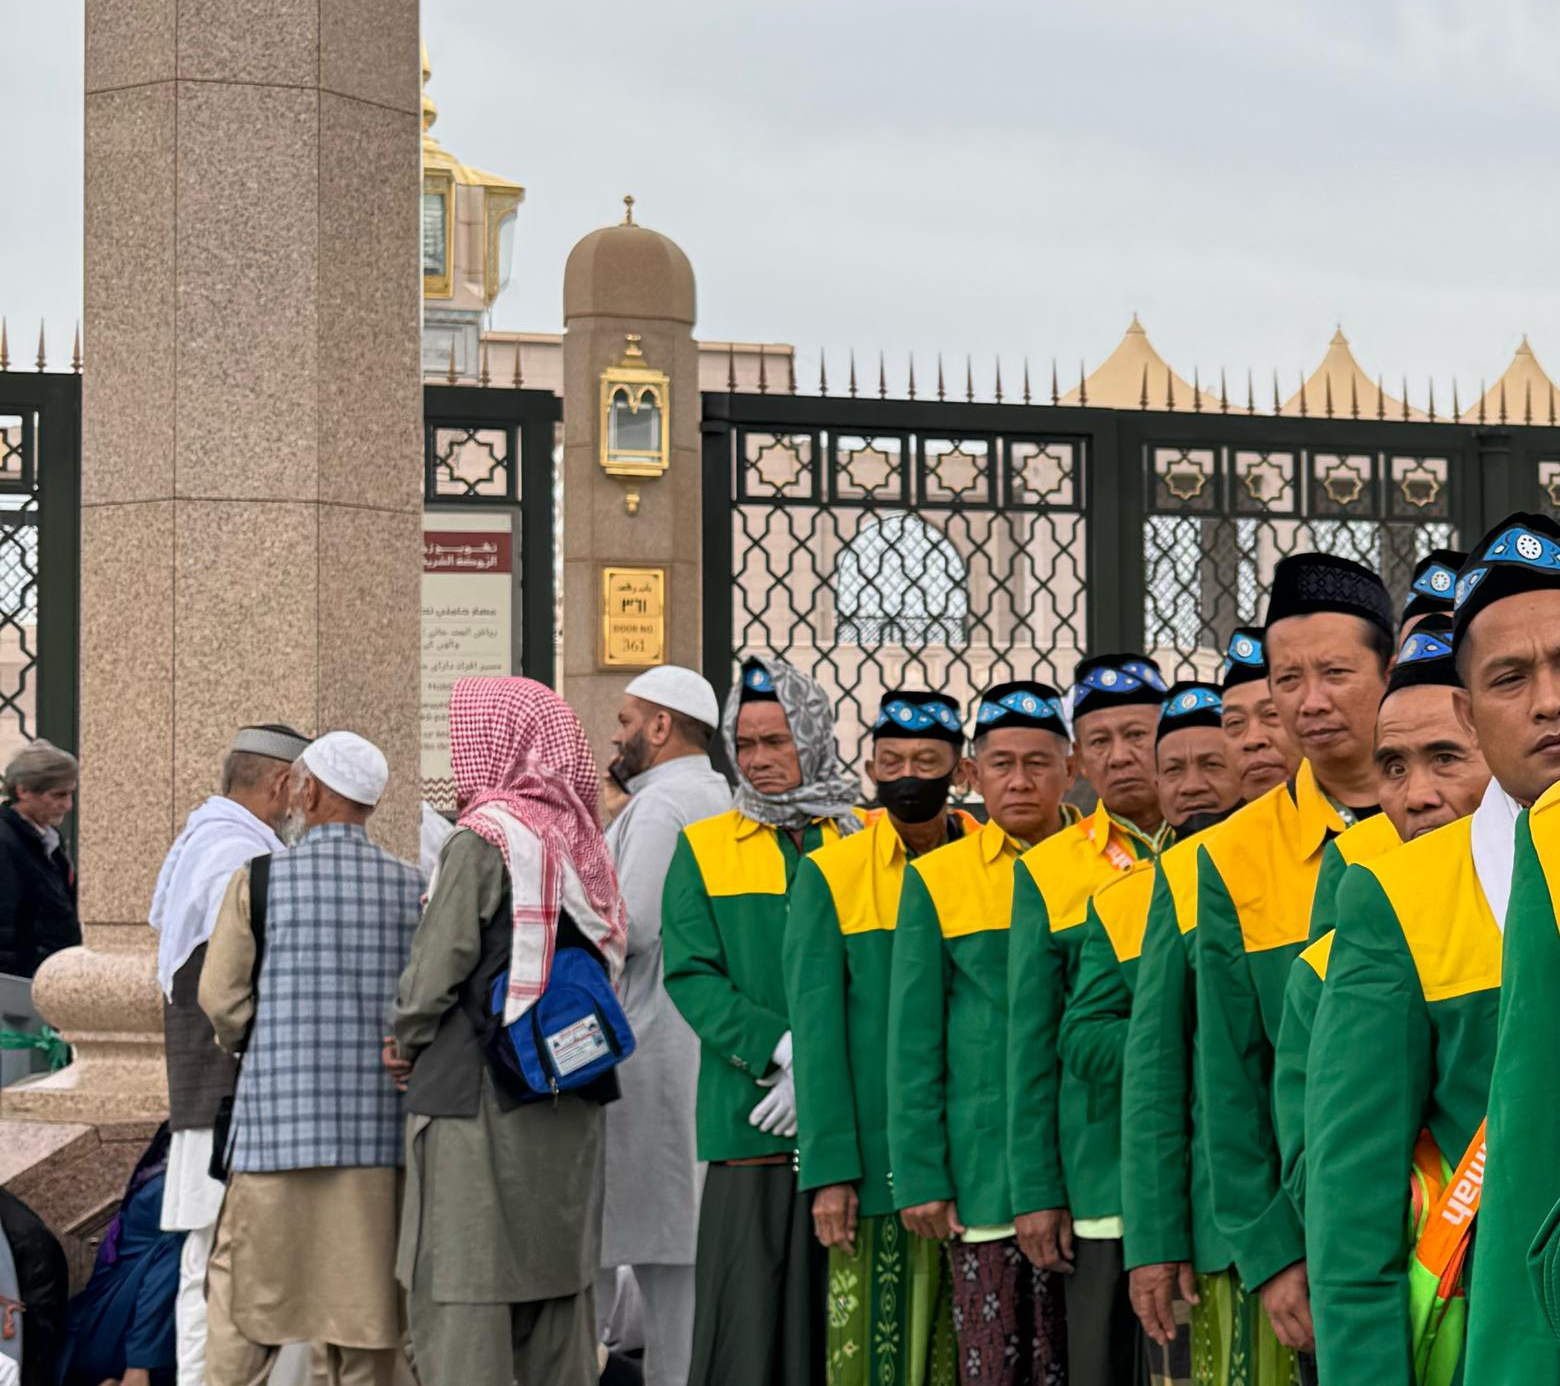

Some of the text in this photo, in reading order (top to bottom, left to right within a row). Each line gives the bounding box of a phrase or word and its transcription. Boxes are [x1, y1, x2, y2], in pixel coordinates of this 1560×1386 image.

[621, 598, 647, 614] ٣٦١
[613, 624, 638, 633] DOOR
[623, 638, 645, 653] 361
